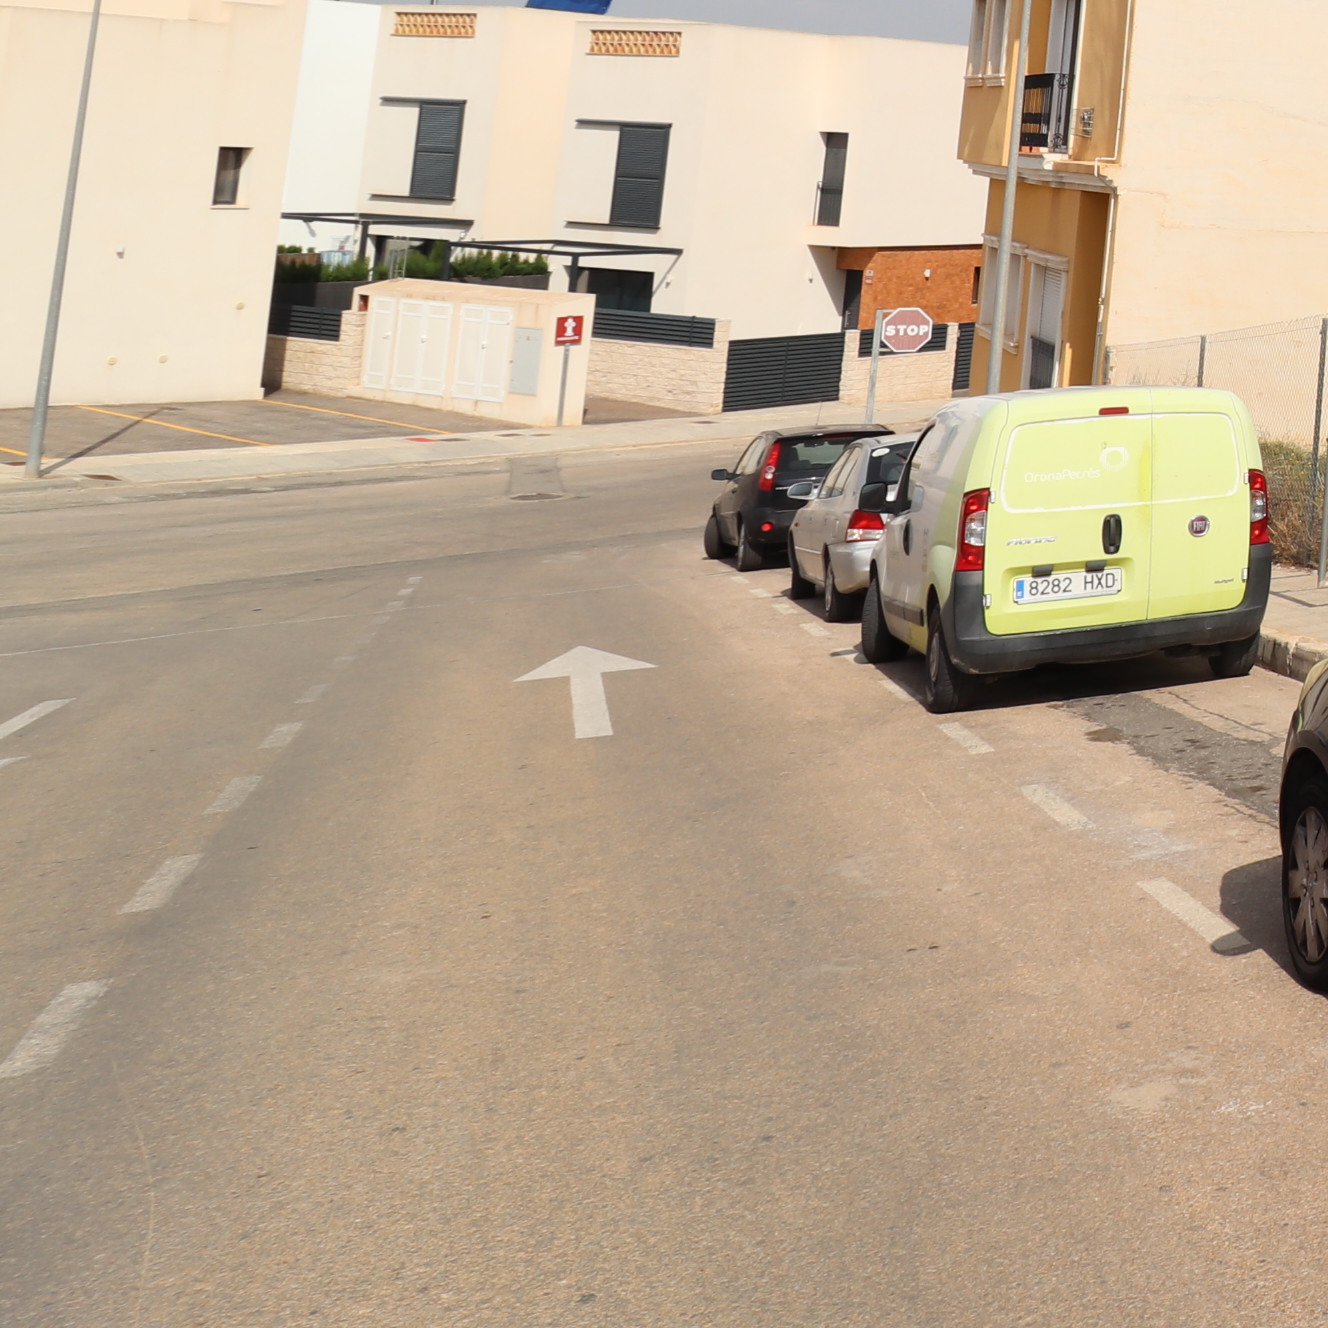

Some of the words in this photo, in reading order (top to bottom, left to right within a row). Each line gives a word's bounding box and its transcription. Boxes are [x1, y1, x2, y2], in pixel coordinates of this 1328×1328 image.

[885, 324, 929, 336] STOP
[1193, 520, 1206, 532] FIAT
[1029, 577, 1072, 596] 8282
[1084, 572, 1115, 591] HXD
